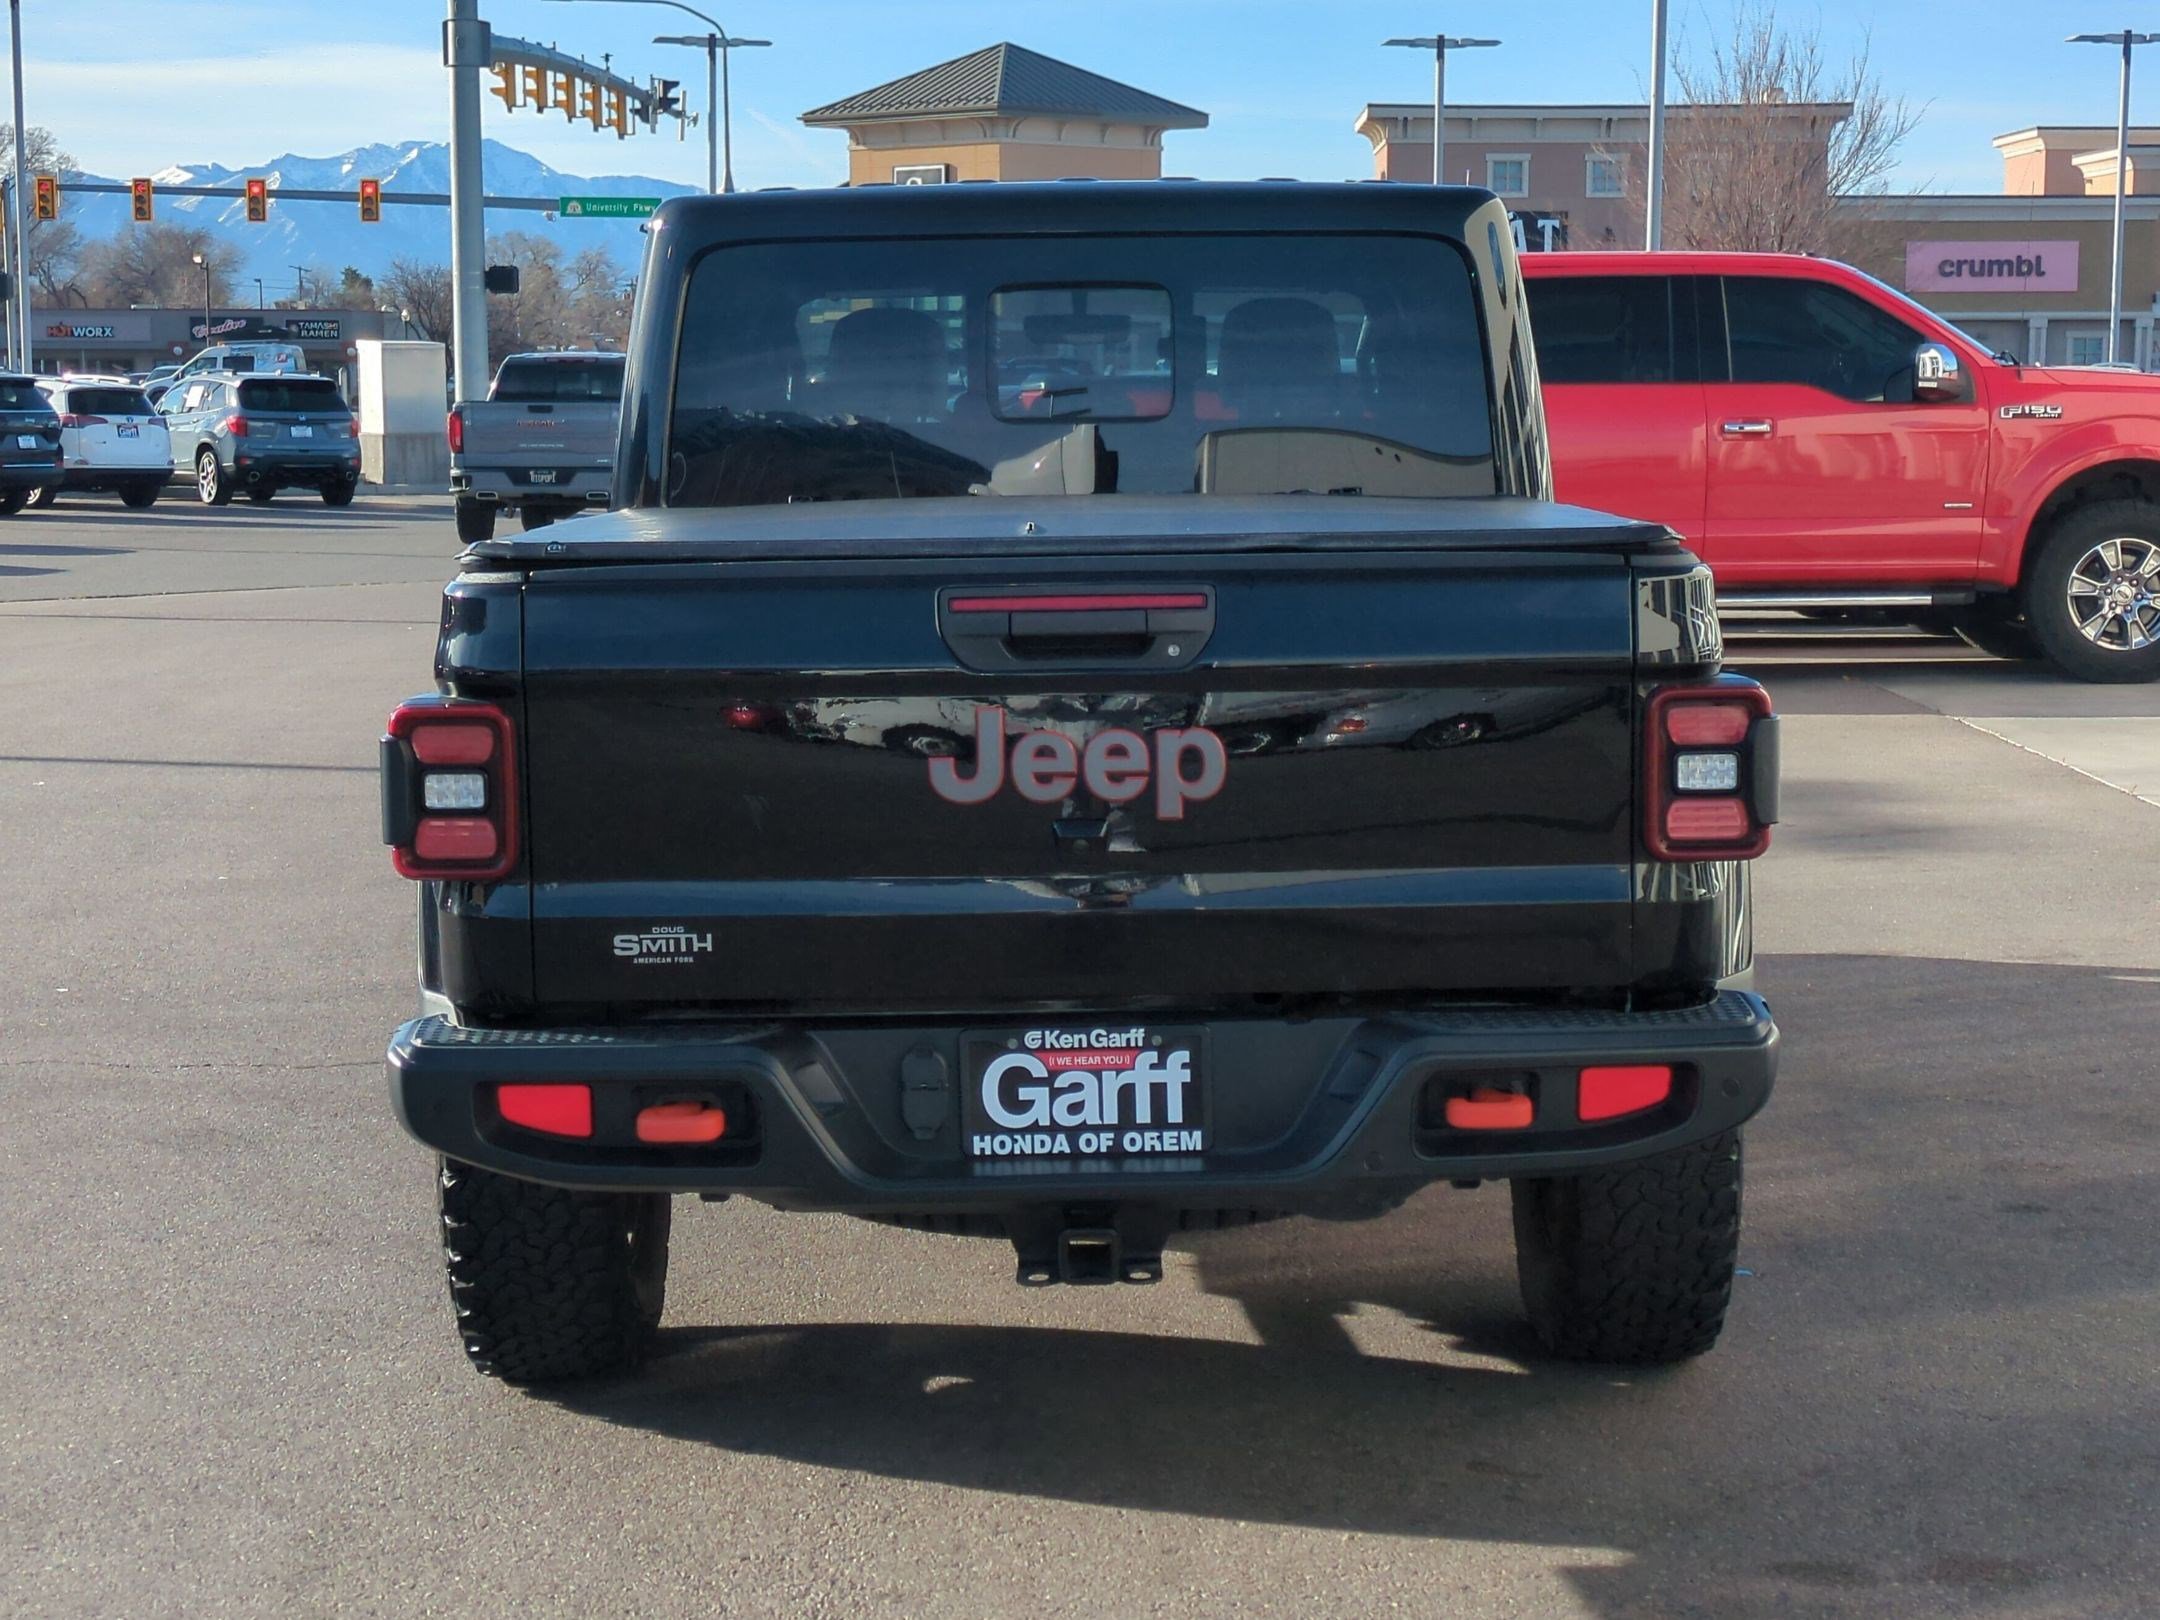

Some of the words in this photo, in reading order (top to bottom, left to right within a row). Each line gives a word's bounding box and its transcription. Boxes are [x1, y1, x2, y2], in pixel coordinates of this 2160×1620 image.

[586, 203, 628, 213] University
[1938, 255, 2046, 278] crumbl
[47, 322, 113, 338] HOTWORX
[301, 330, 338, 338] RAMEN
[928, 705, 1227, 820] Jeep
[652, 926, 685, 934] DOUG
[613, 933, 712, 956] SMITH
[1045, 1031, 1088, 1049] Ken
[1090, 1028, 1145, 1048] Garff
[1056, 1057, 1073, 1065] WE
[1075, 1056, 1101, 1065] HEAR
[1102, 1055, 1124, 1064] YOU
[982, 1050, 1191, 1129] Garff
[973, 1133, 1071, 1156] HONDA
[1078, 1133, 1115, 1154] OF
[1122, 1130, 1203, 1153] OREM
